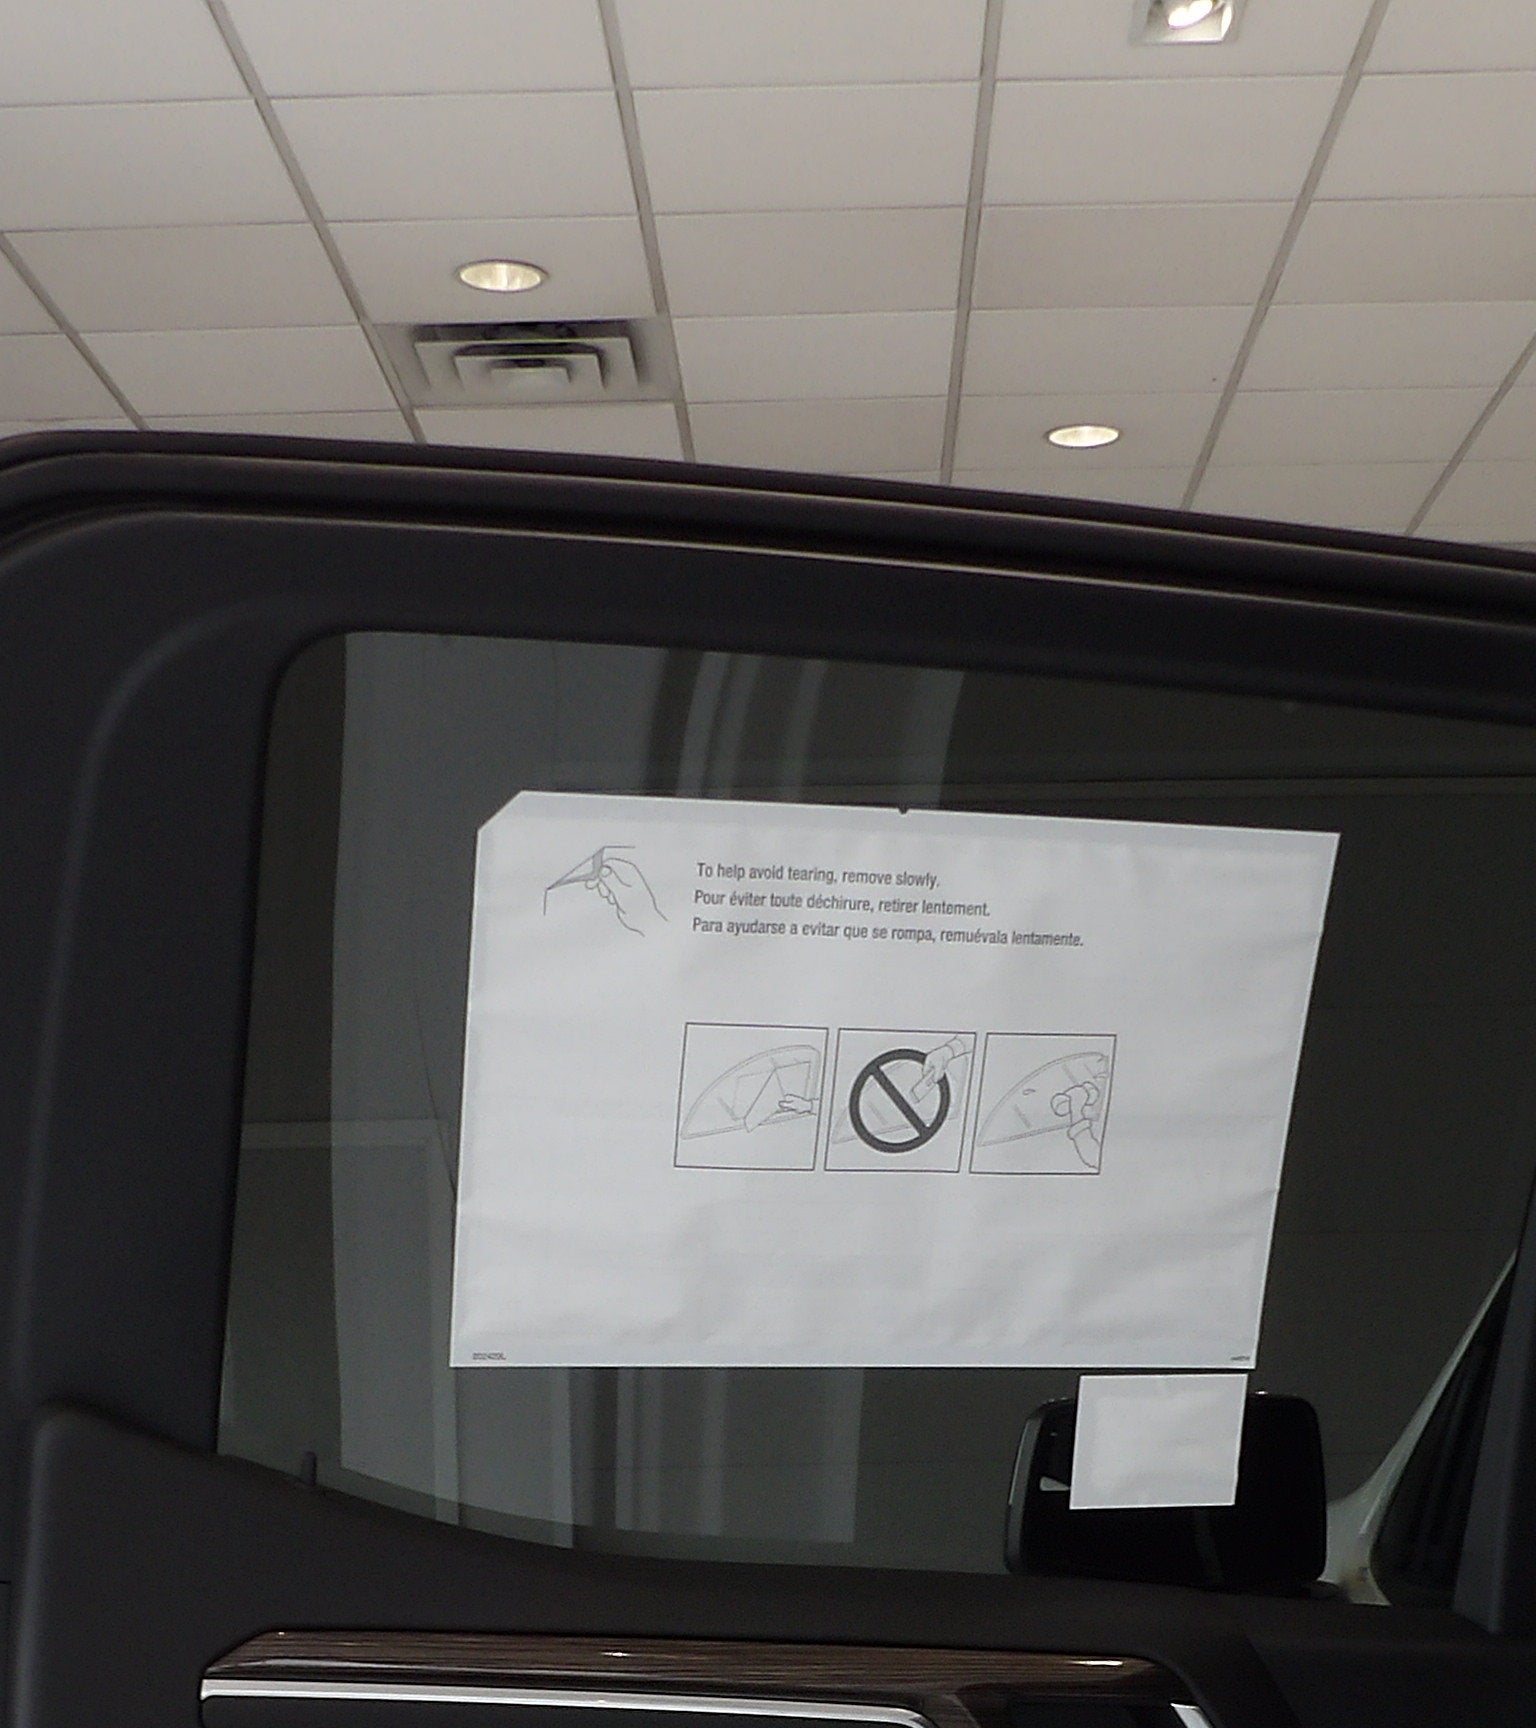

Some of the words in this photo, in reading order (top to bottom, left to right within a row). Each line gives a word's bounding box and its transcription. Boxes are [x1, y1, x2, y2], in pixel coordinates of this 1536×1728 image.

[697, 862, 713, 878] To
[717, 863, 745, 881] help
[749, 865, 783, 881] avoid
[788, 867, 837, 885] tearing,
[842, 870, 892, 886] remove
[896, 871, 940, 890] slowly.
[694, 889, 725, 905] Pour
[729, 890, 766, 907] éviter
[770, 893, 802, 908] toute
[806, 893, 874, 912] déchirure,
[879, 898, 918, 914] retirer
[922, 900, 990, 917] lentement.
[692, 917, 722, 933] Para
[726, 919, 785, 936] ayudarse
[790, 923, 798, 935] a
[802, 922, 839, 937] evitar
[843, 926, 867, 941] que
[872, 927, 888, 940] se
[891, 929, 936, 944] rompa,
[940, 928, 1008, 945] remuévala
[1012, 930, 1084, 947] lentamente.
